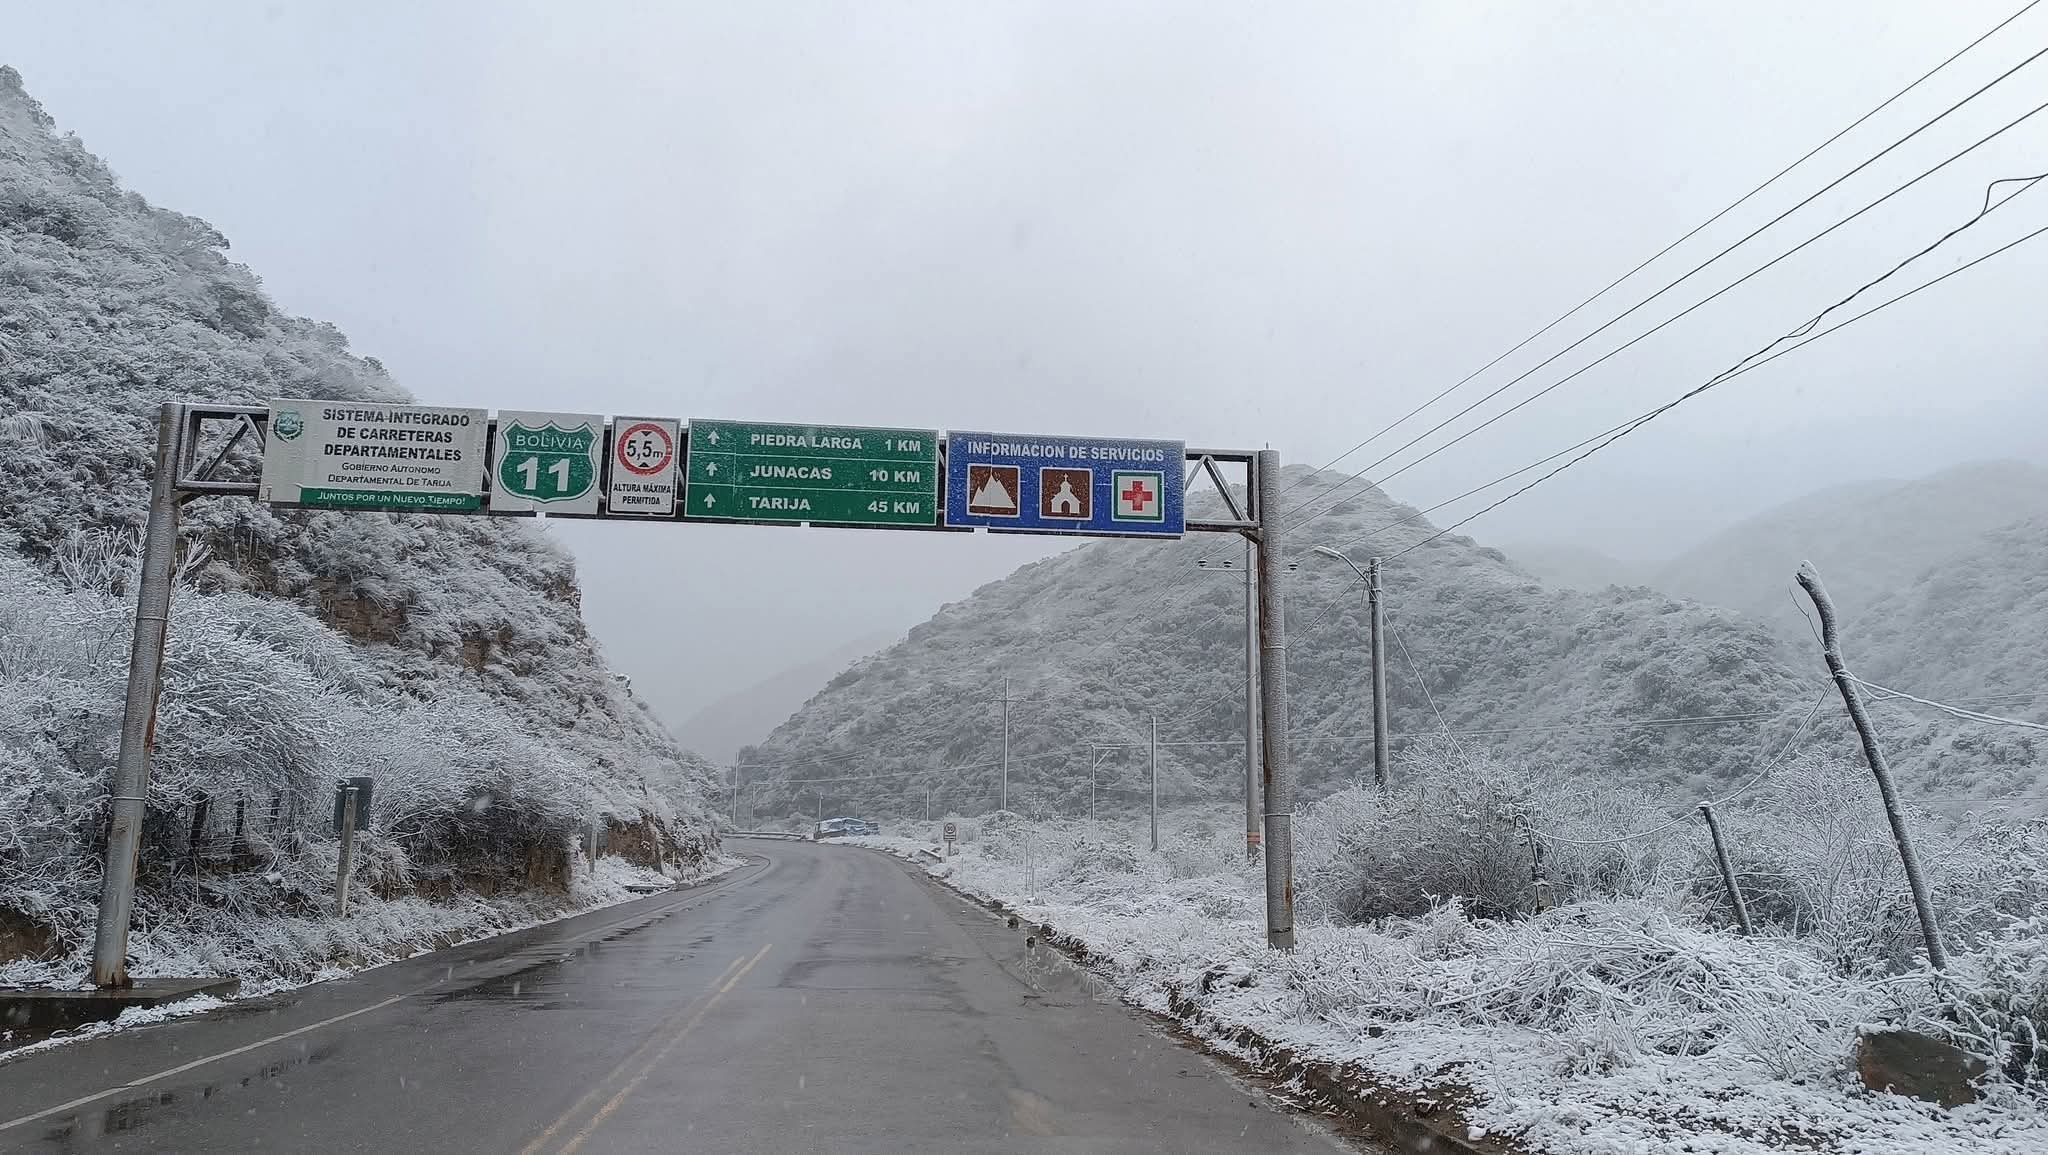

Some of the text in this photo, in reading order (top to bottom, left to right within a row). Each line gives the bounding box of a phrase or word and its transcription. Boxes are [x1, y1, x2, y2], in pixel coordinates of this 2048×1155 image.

[323, 409, 470, 427] SISTEMA INTEGRADO
[337, 427, 453, 443] DE CARRETERAS
[516, 435, 584, 449] BOLIVIA
[751, 434, 921, 452] PIEDRA LARGA 1 KM
[324, 444, 462, 461] DEPARTAMENTALES
[968, 441, 1165, 462] INFORMACION DE SERVICIOS
[342, 461, 389, 473] GOBIERNO
[517, 456, 570, 492] 11
[750, 465, 920, 483] JUNACAS 10 KM
[328, 474, 452, 487] DEPARTAMENTAL DE TARIJA
[613, 482, 671, 494] ALTURA MÁXIMA
[317, 491, 354, 501] JUNTOS
[356, 493, 376, 502] POR
[377, 494, 391, 503] UN
[393, 494, 425, 504] NUEVO
[622, 495, 661, 505] PERMITIDA
[749, 497, 920, 514] TARIJA 45 KM
